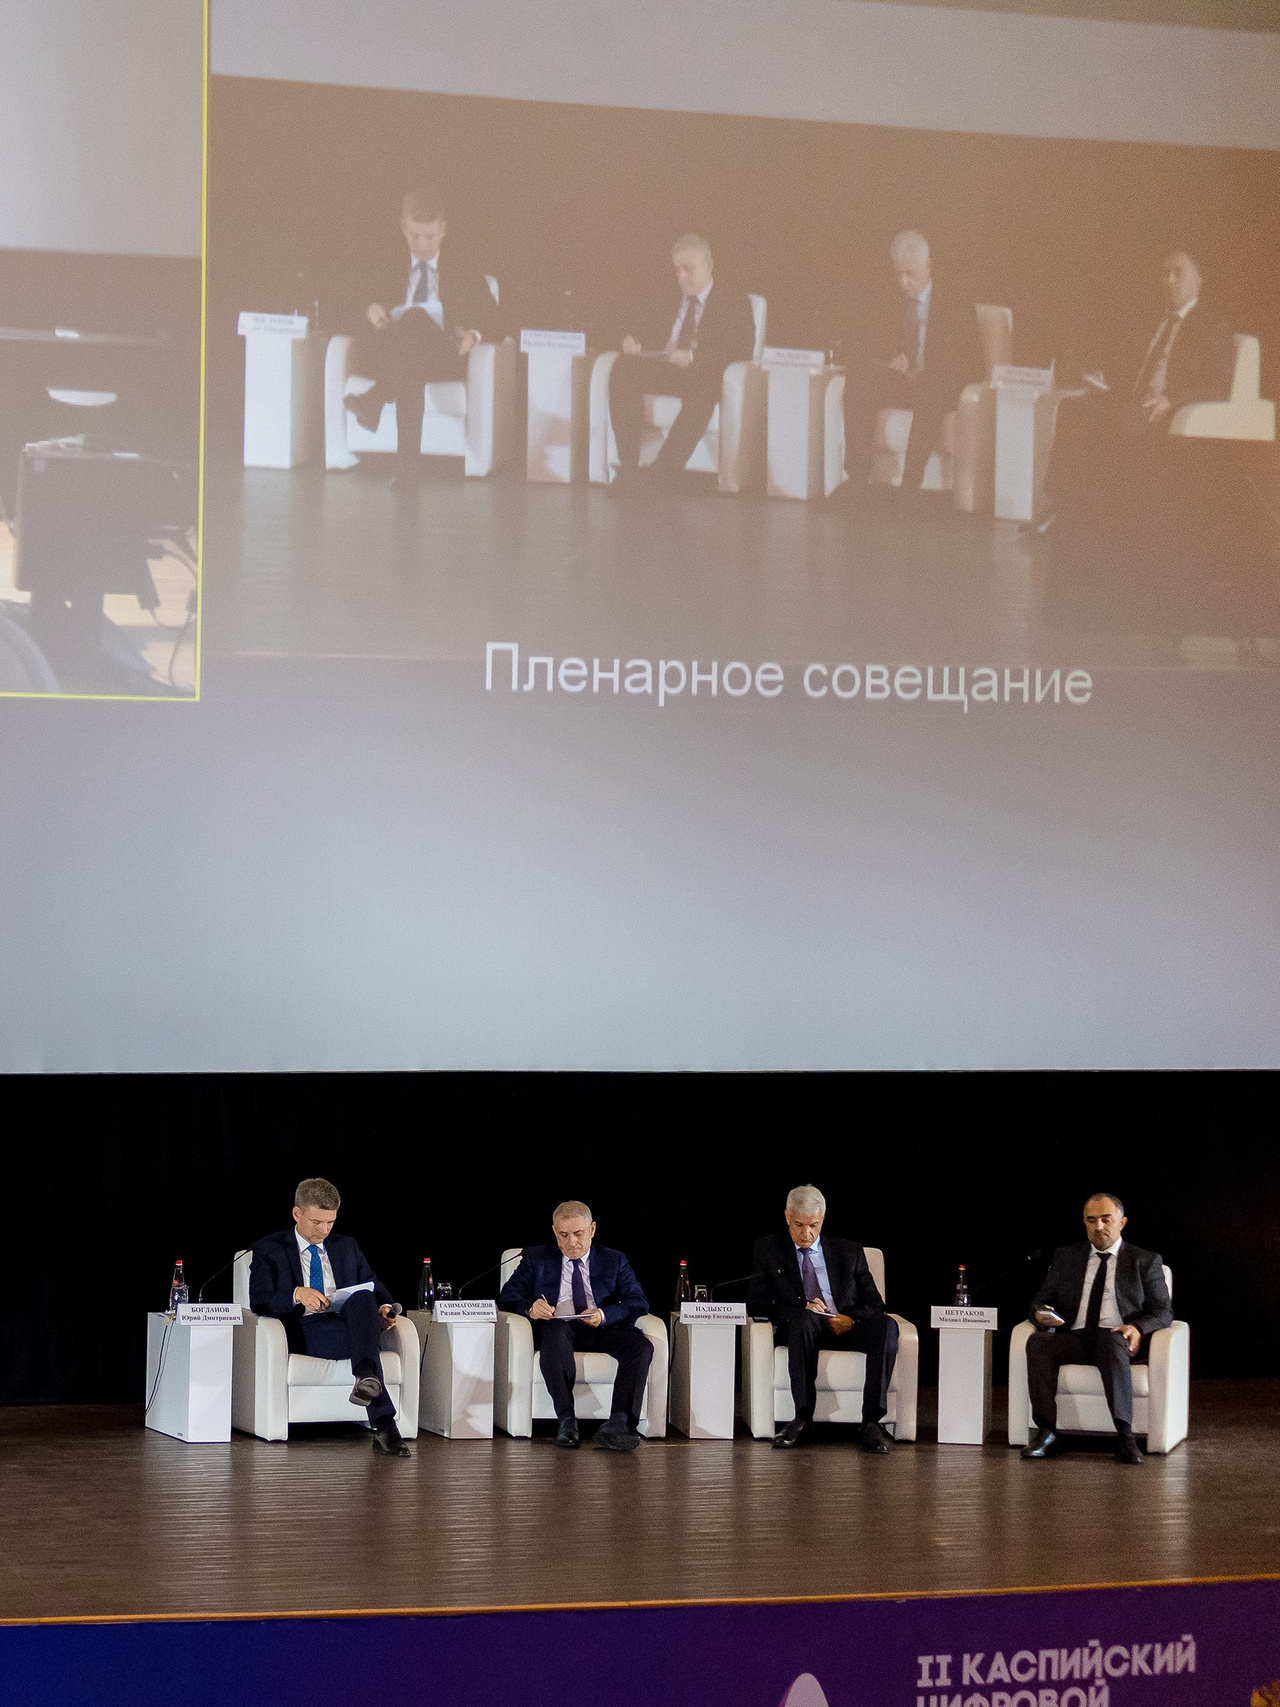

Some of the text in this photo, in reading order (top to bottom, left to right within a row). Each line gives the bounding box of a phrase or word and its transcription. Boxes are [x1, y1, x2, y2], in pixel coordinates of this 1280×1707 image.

[485, 642, 1093, 713] Пленарное совещание
[191, 1306, 230, 1314] БОГДАНОВ
[945, 1309, 985, 1317] ПЕТРАКОВ
[917, 1633, 1196, 1687] II КАСПИЙСКИЙ
